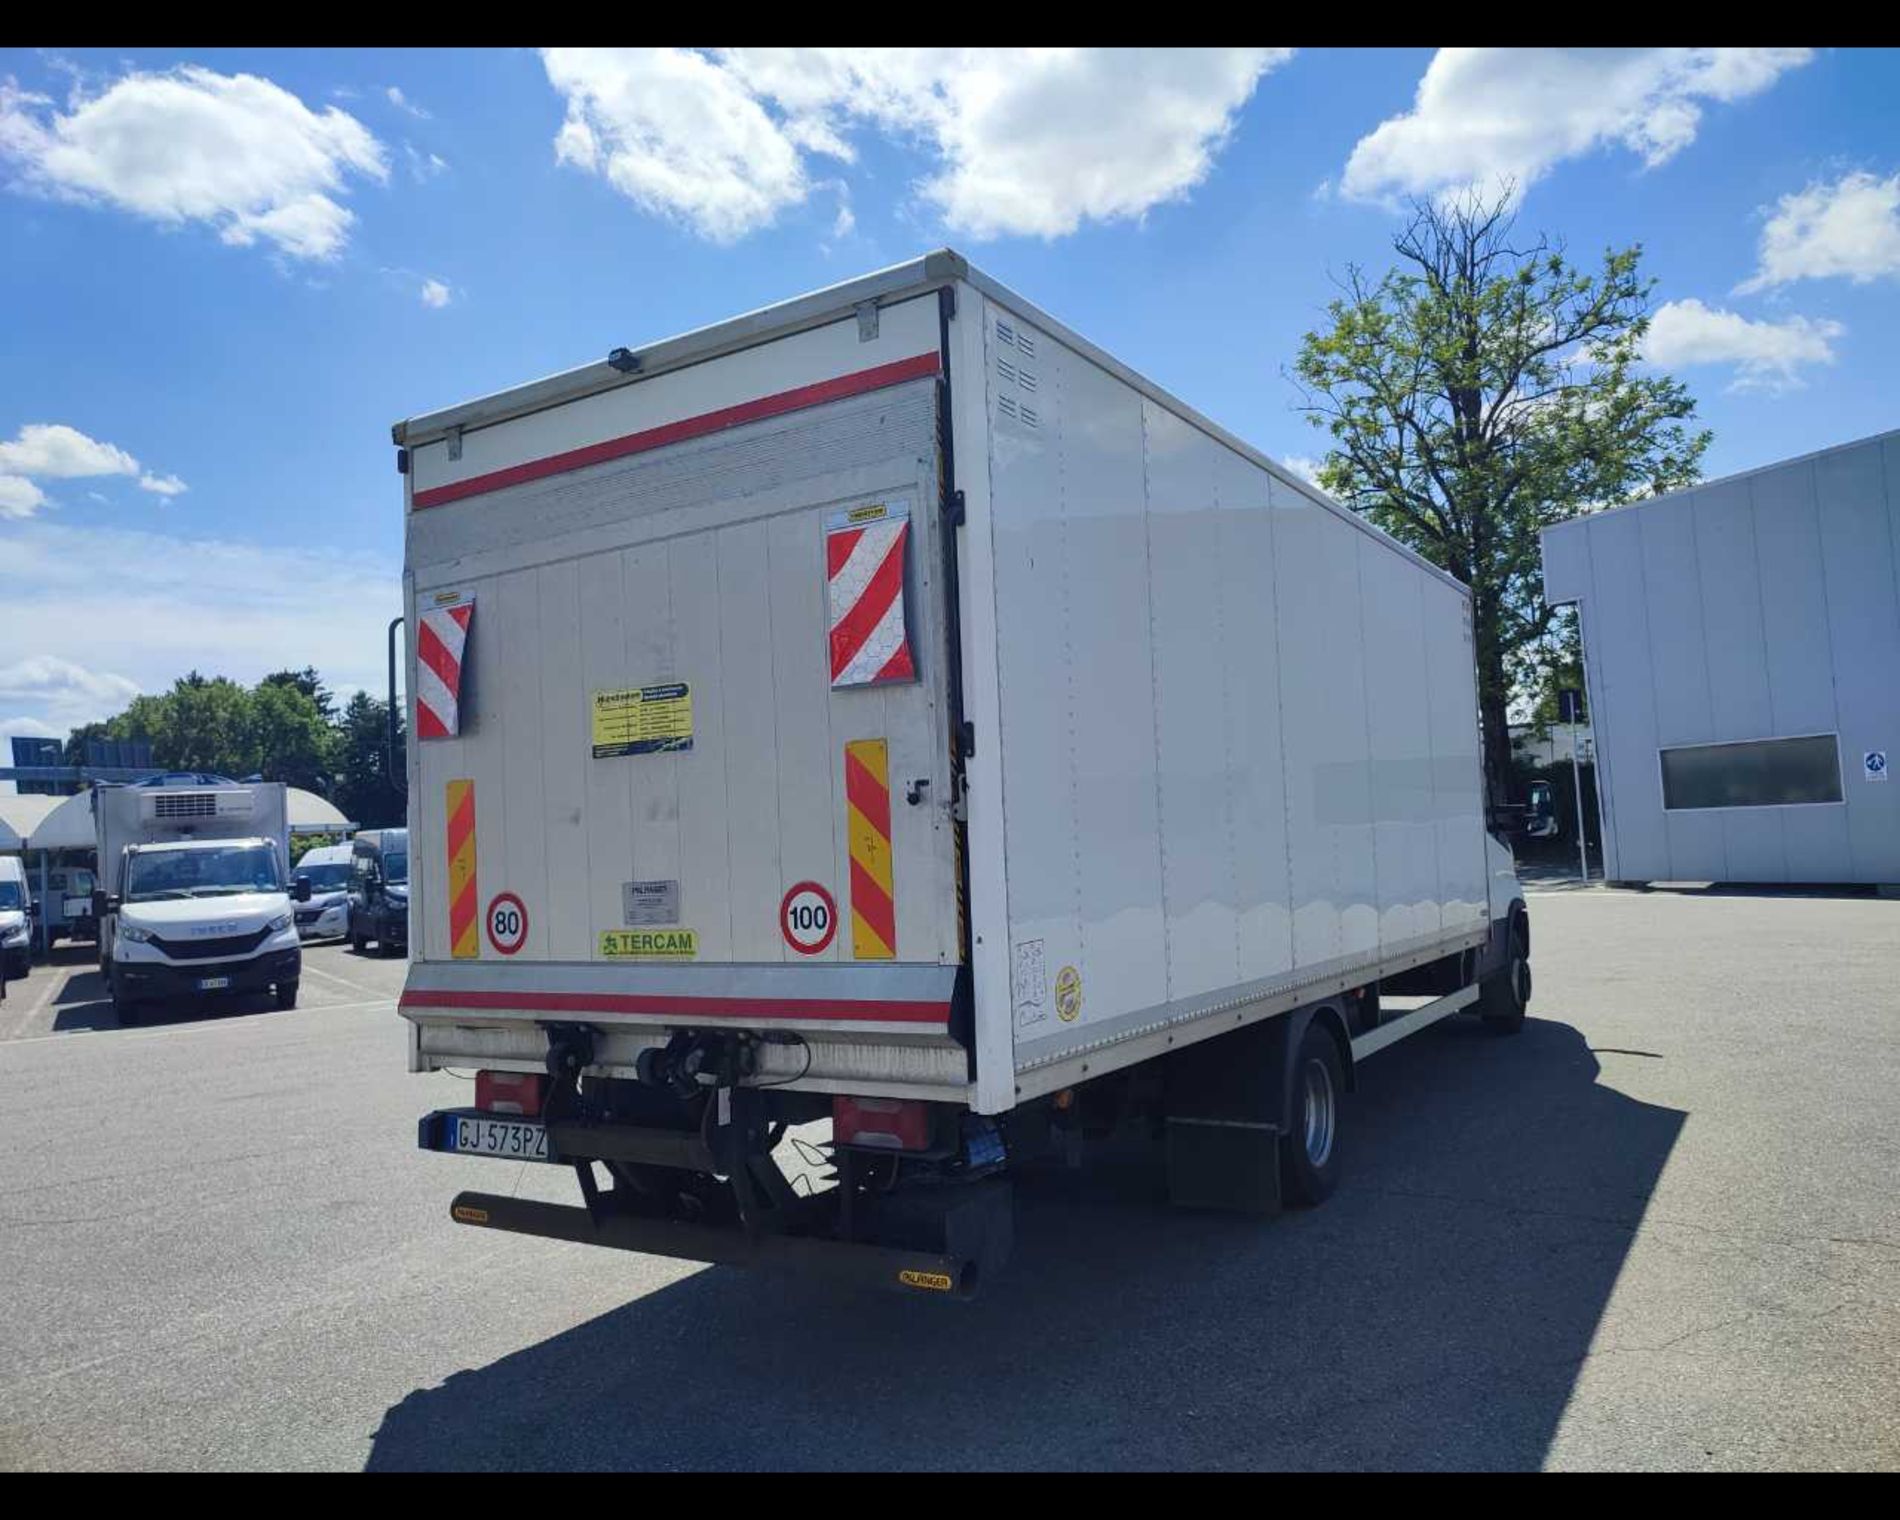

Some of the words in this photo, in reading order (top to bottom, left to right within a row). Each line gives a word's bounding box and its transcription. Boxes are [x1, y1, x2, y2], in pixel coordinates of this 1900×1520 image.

[495, 911, 519, 935] 80
[789, 906, 827, 930] 100
[620, 934, 693, 950] TERCAM
